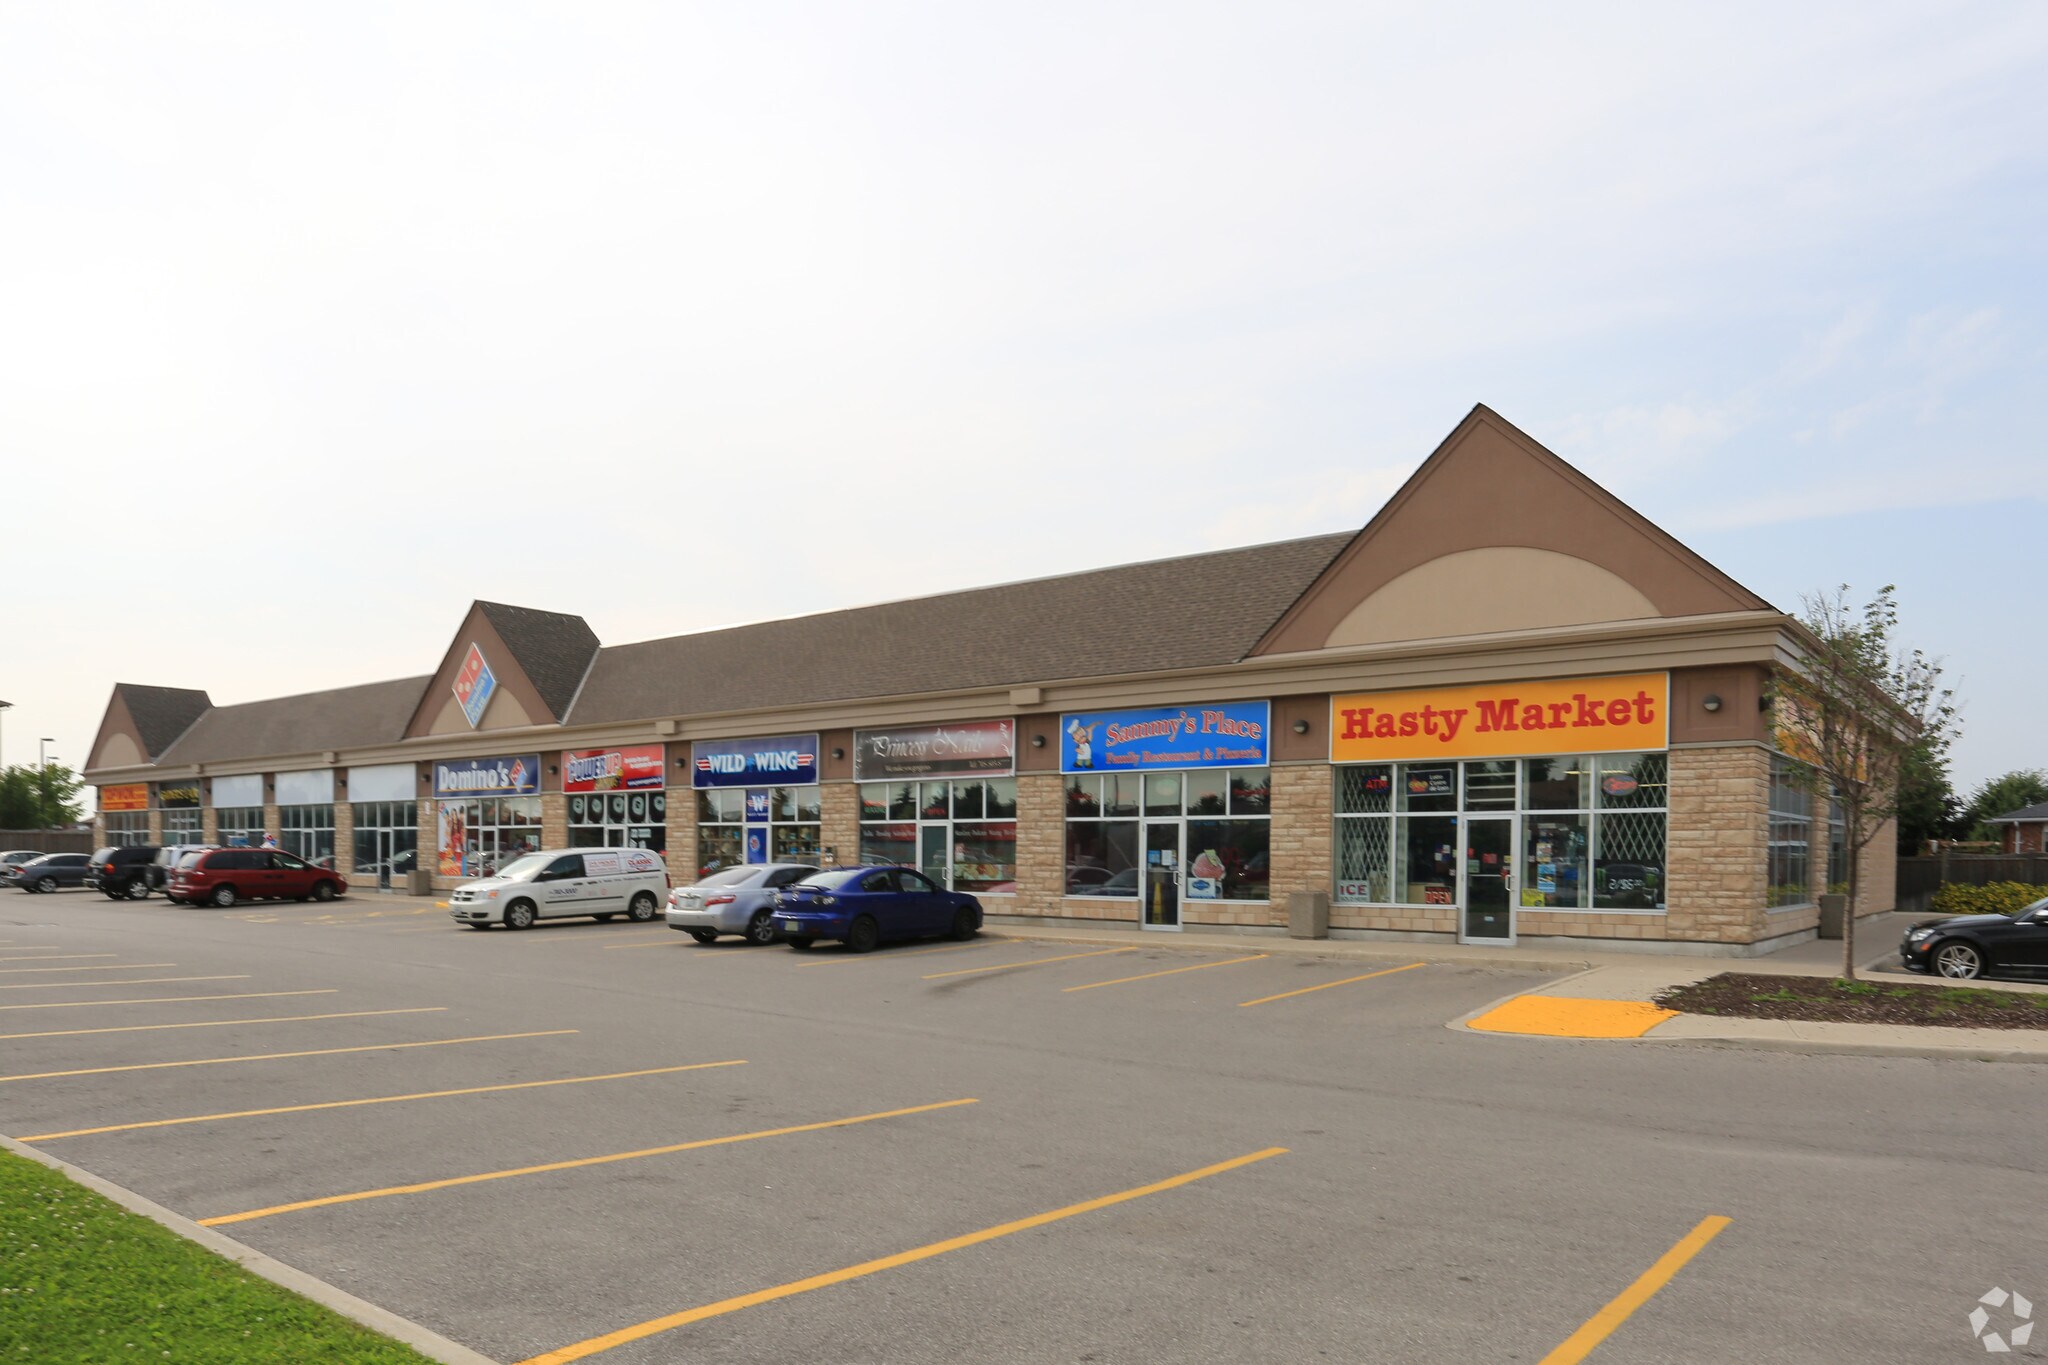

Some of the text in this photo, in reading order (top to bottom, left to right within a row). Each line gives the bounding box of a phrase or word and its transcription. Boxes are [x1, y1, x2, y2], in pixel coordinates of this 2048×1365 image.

[1341, 690, 1655, 742] Hasty Market
[1105, 710, 1262, 748] Sammy's Place
[707, 750, 799, 774] WILD WING
[1106, 746, 1262, 766] Family Restaurant & Pizzeria
[437, 760, 510, 791] Domino's
[1365, 778, 1389, 790] ATM
[1340, 884, 1367, 896] ICE
[1425, 891, 1452, 904] OPEN
